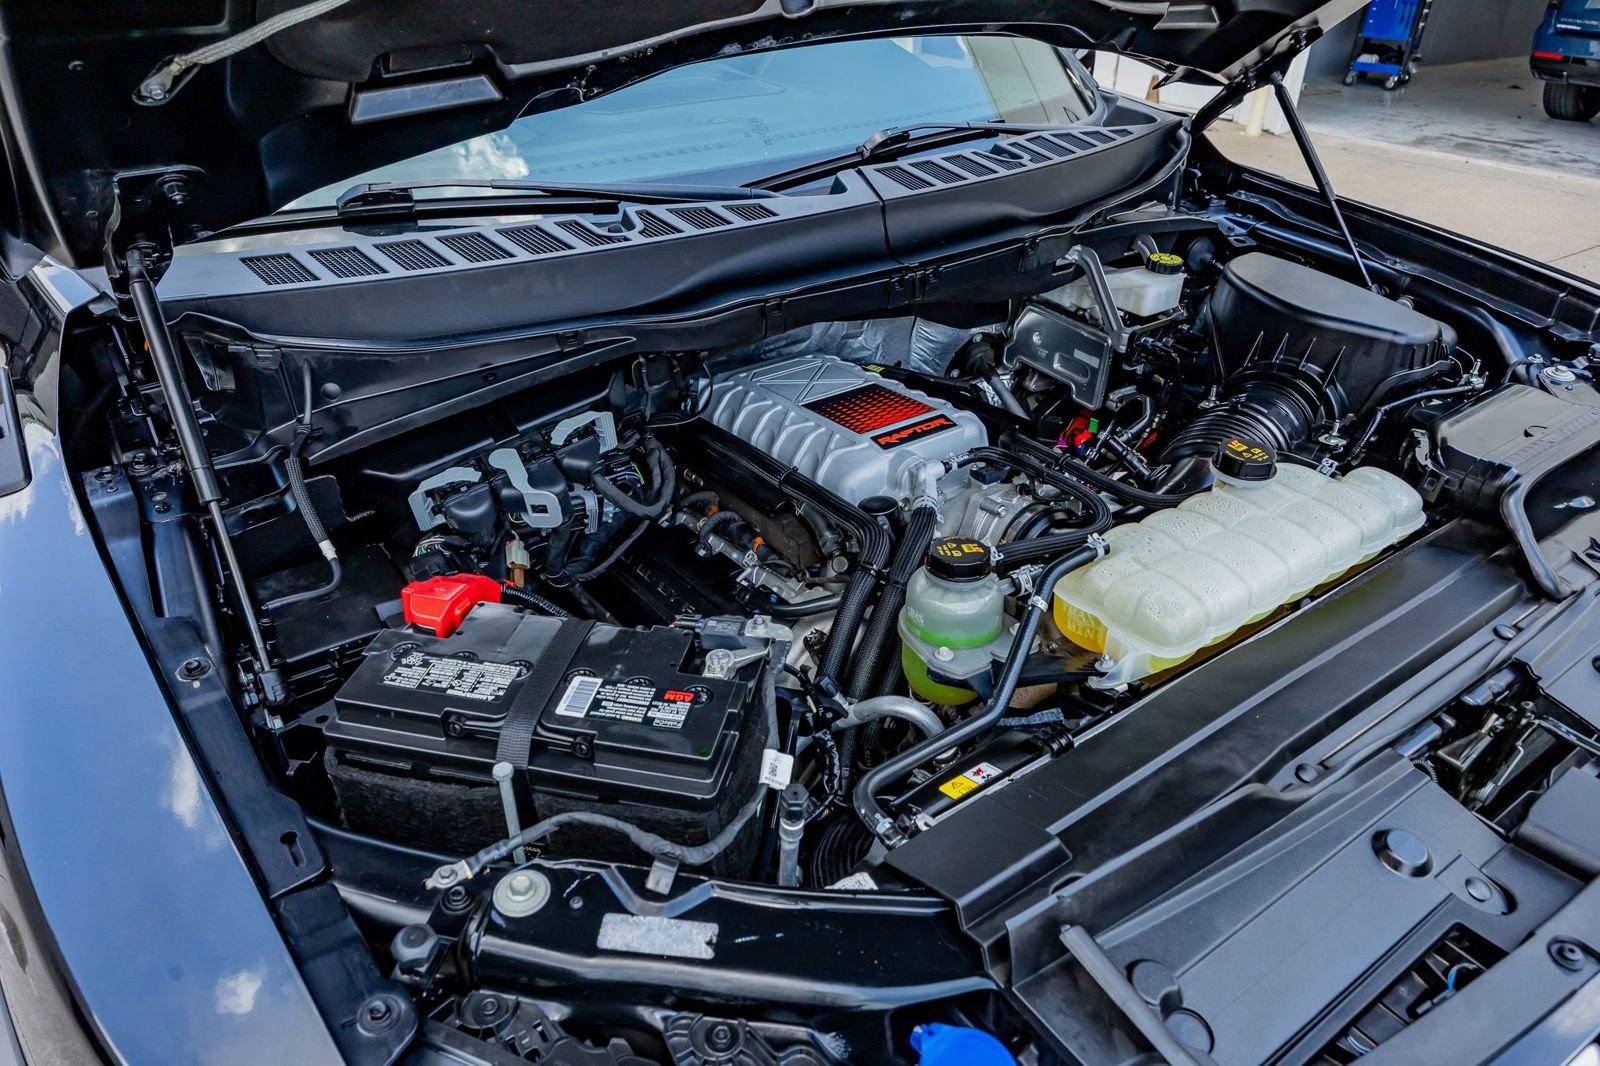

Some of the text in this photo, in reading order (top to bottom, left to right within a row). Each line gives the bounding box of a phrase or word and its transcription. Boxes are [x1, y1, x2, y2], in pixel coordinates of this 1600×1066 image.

[877, 417, 954, 445] RAPTOR
[664, 692, 694, 702] AGM
[655, 719, 682, 727] FoMoCo
